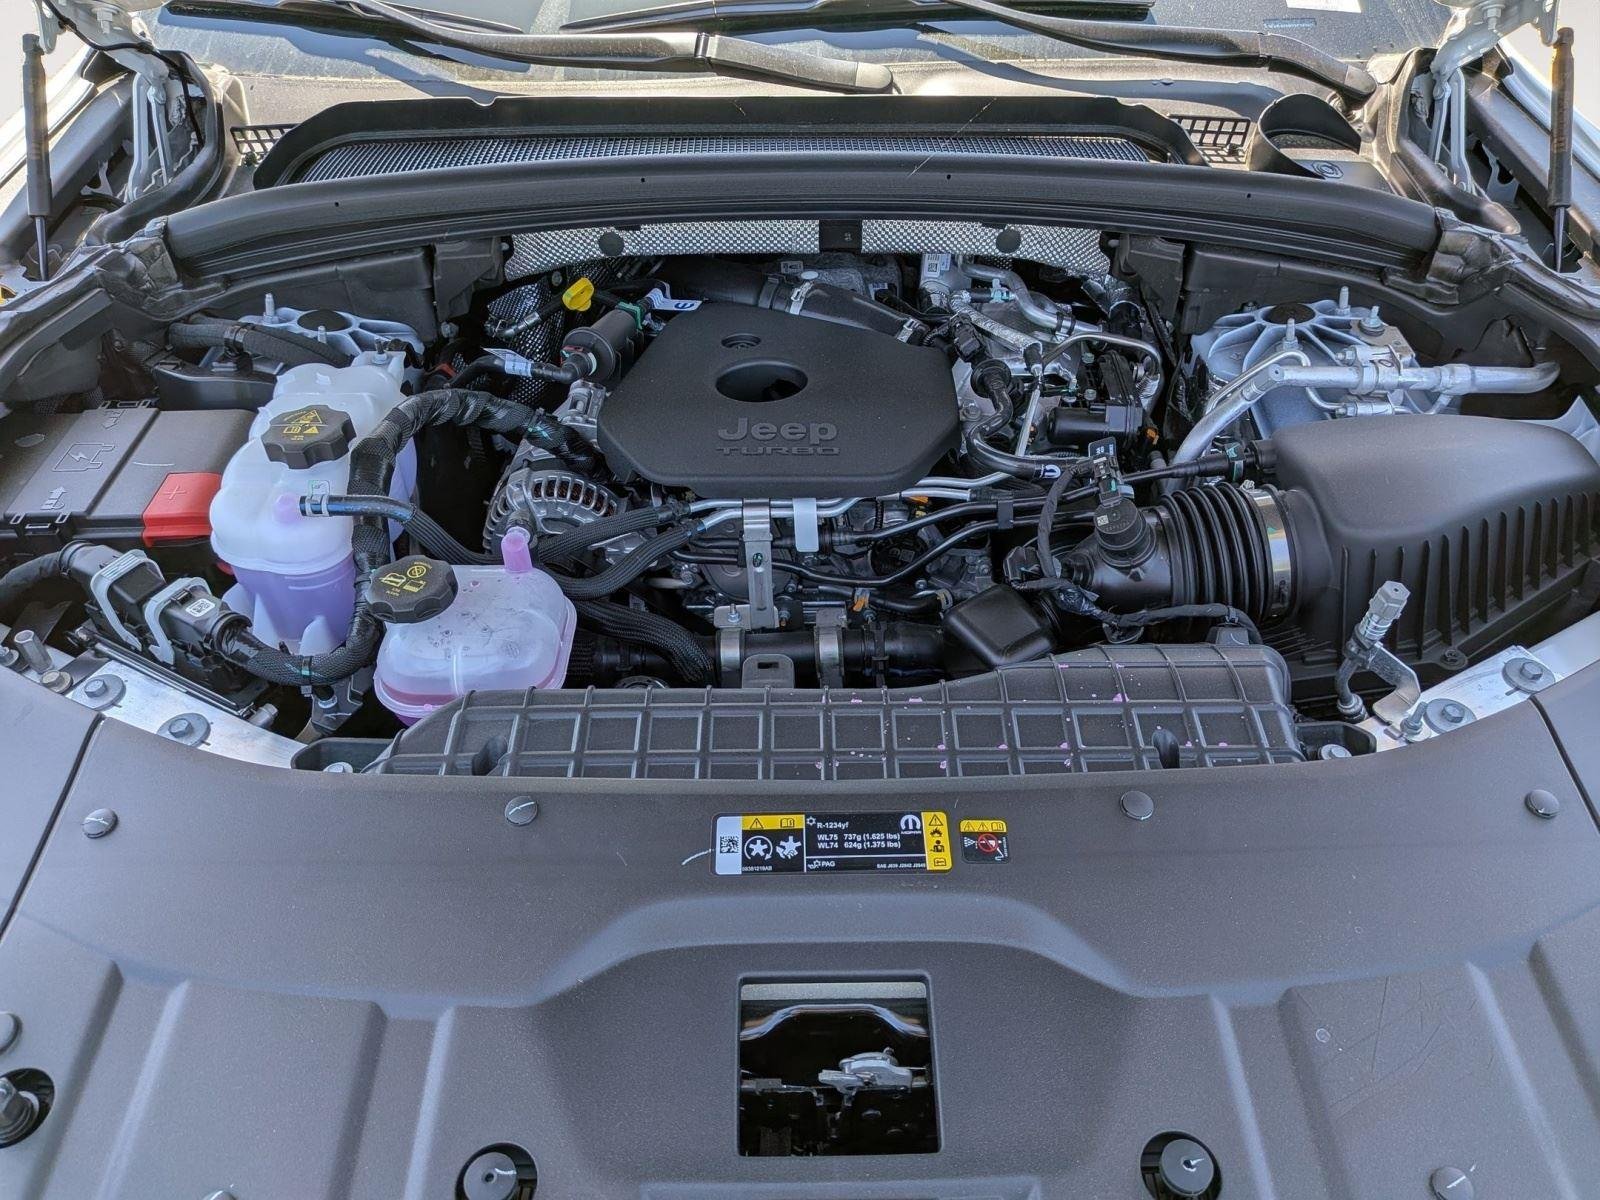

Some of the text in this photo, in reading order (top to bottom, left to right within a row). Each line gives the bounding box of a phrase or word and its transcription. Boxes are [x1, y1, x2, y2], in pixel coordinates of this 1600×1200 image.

[718, 417, 838, 445] Jeep
[717, 446, 840, 456] TURBO
[816, 821, 849, 830] R-1234yf
[817, 832, 900, 842] WL75 737g (1.625 lbs)
[886, 841, 901, 849] lbs)
